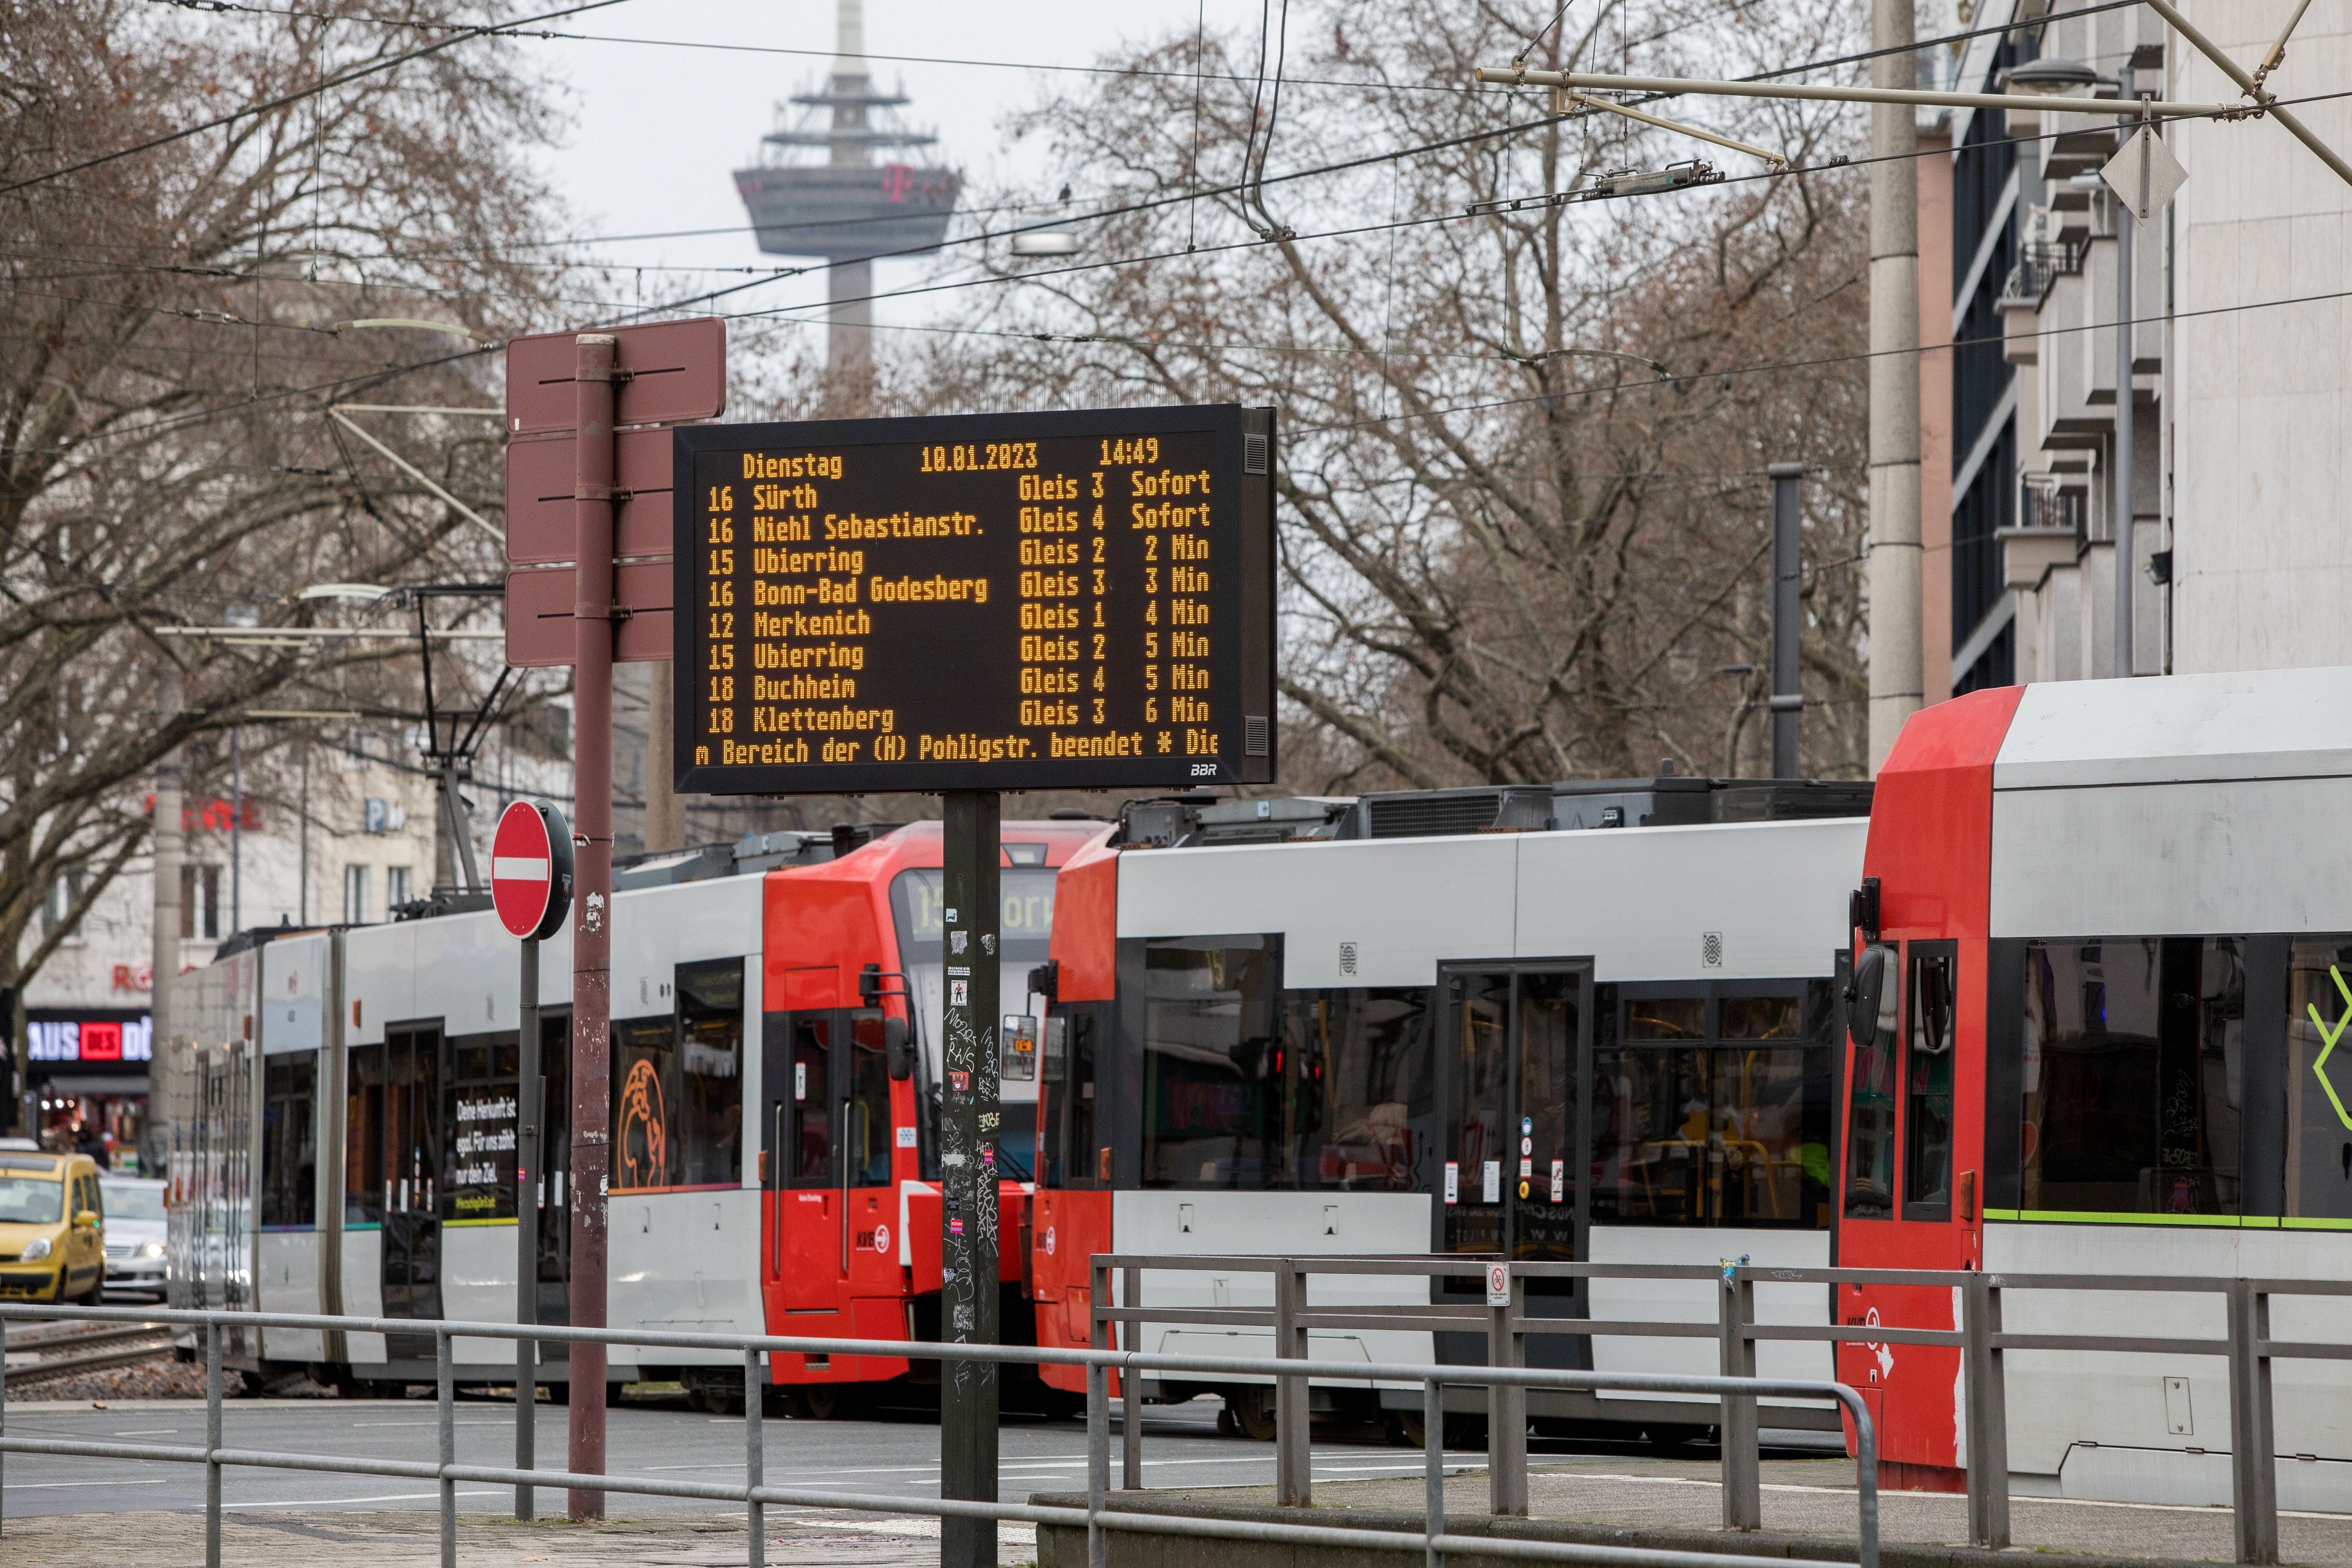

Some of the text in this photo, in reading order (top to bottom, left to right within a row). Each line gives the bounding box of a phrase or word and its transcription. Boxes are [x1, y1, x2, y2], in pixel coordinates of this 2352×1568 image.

[744, 438, 1158, 479] Dienstag 10.01.2023 14:49
[709, 470, 1210, 511] 16 Sürth Gleis 3 Sofort
[709, 502, 1210, 543] 16 Niehl Sebastianstr. Gleis 4 Sofort
[709, 534, 1208, 574] 15 Ubierring Gleis 2 2 Min
[709, 567, 1208, 606] 16 Bonn-Bad Godesberg Gleis 3 3 Min
[710, 599, 1208, 638] 12 Merkenich Gleis 1 4 Min
[710, 632, 1208, 670] 15 Ubierring Gleis 2 5 Min
[710, 664, 1208, 701] 18 Buchheim Gleis 4 5 Min
[709, 697, 1208, 733] 18 Klettenberg Gleis 3 6 Min
[724, 738, 808, 764] Bereich
[823, 737, 860, 761] der
[874, 736, 906, 760] (H)
[920, 734, 1036, 762] Pohligstr.
[1051, 731, 1142, 757] beendet
[1191, 764, 1217, 776] BBR
[457, 1096, 517, 1121] Deine Herkunft ist
[473, 1131, 485, 1152] Für
[468, 1162, 483, 1184] dein
[856, 1231, 875, 1247] KVB
